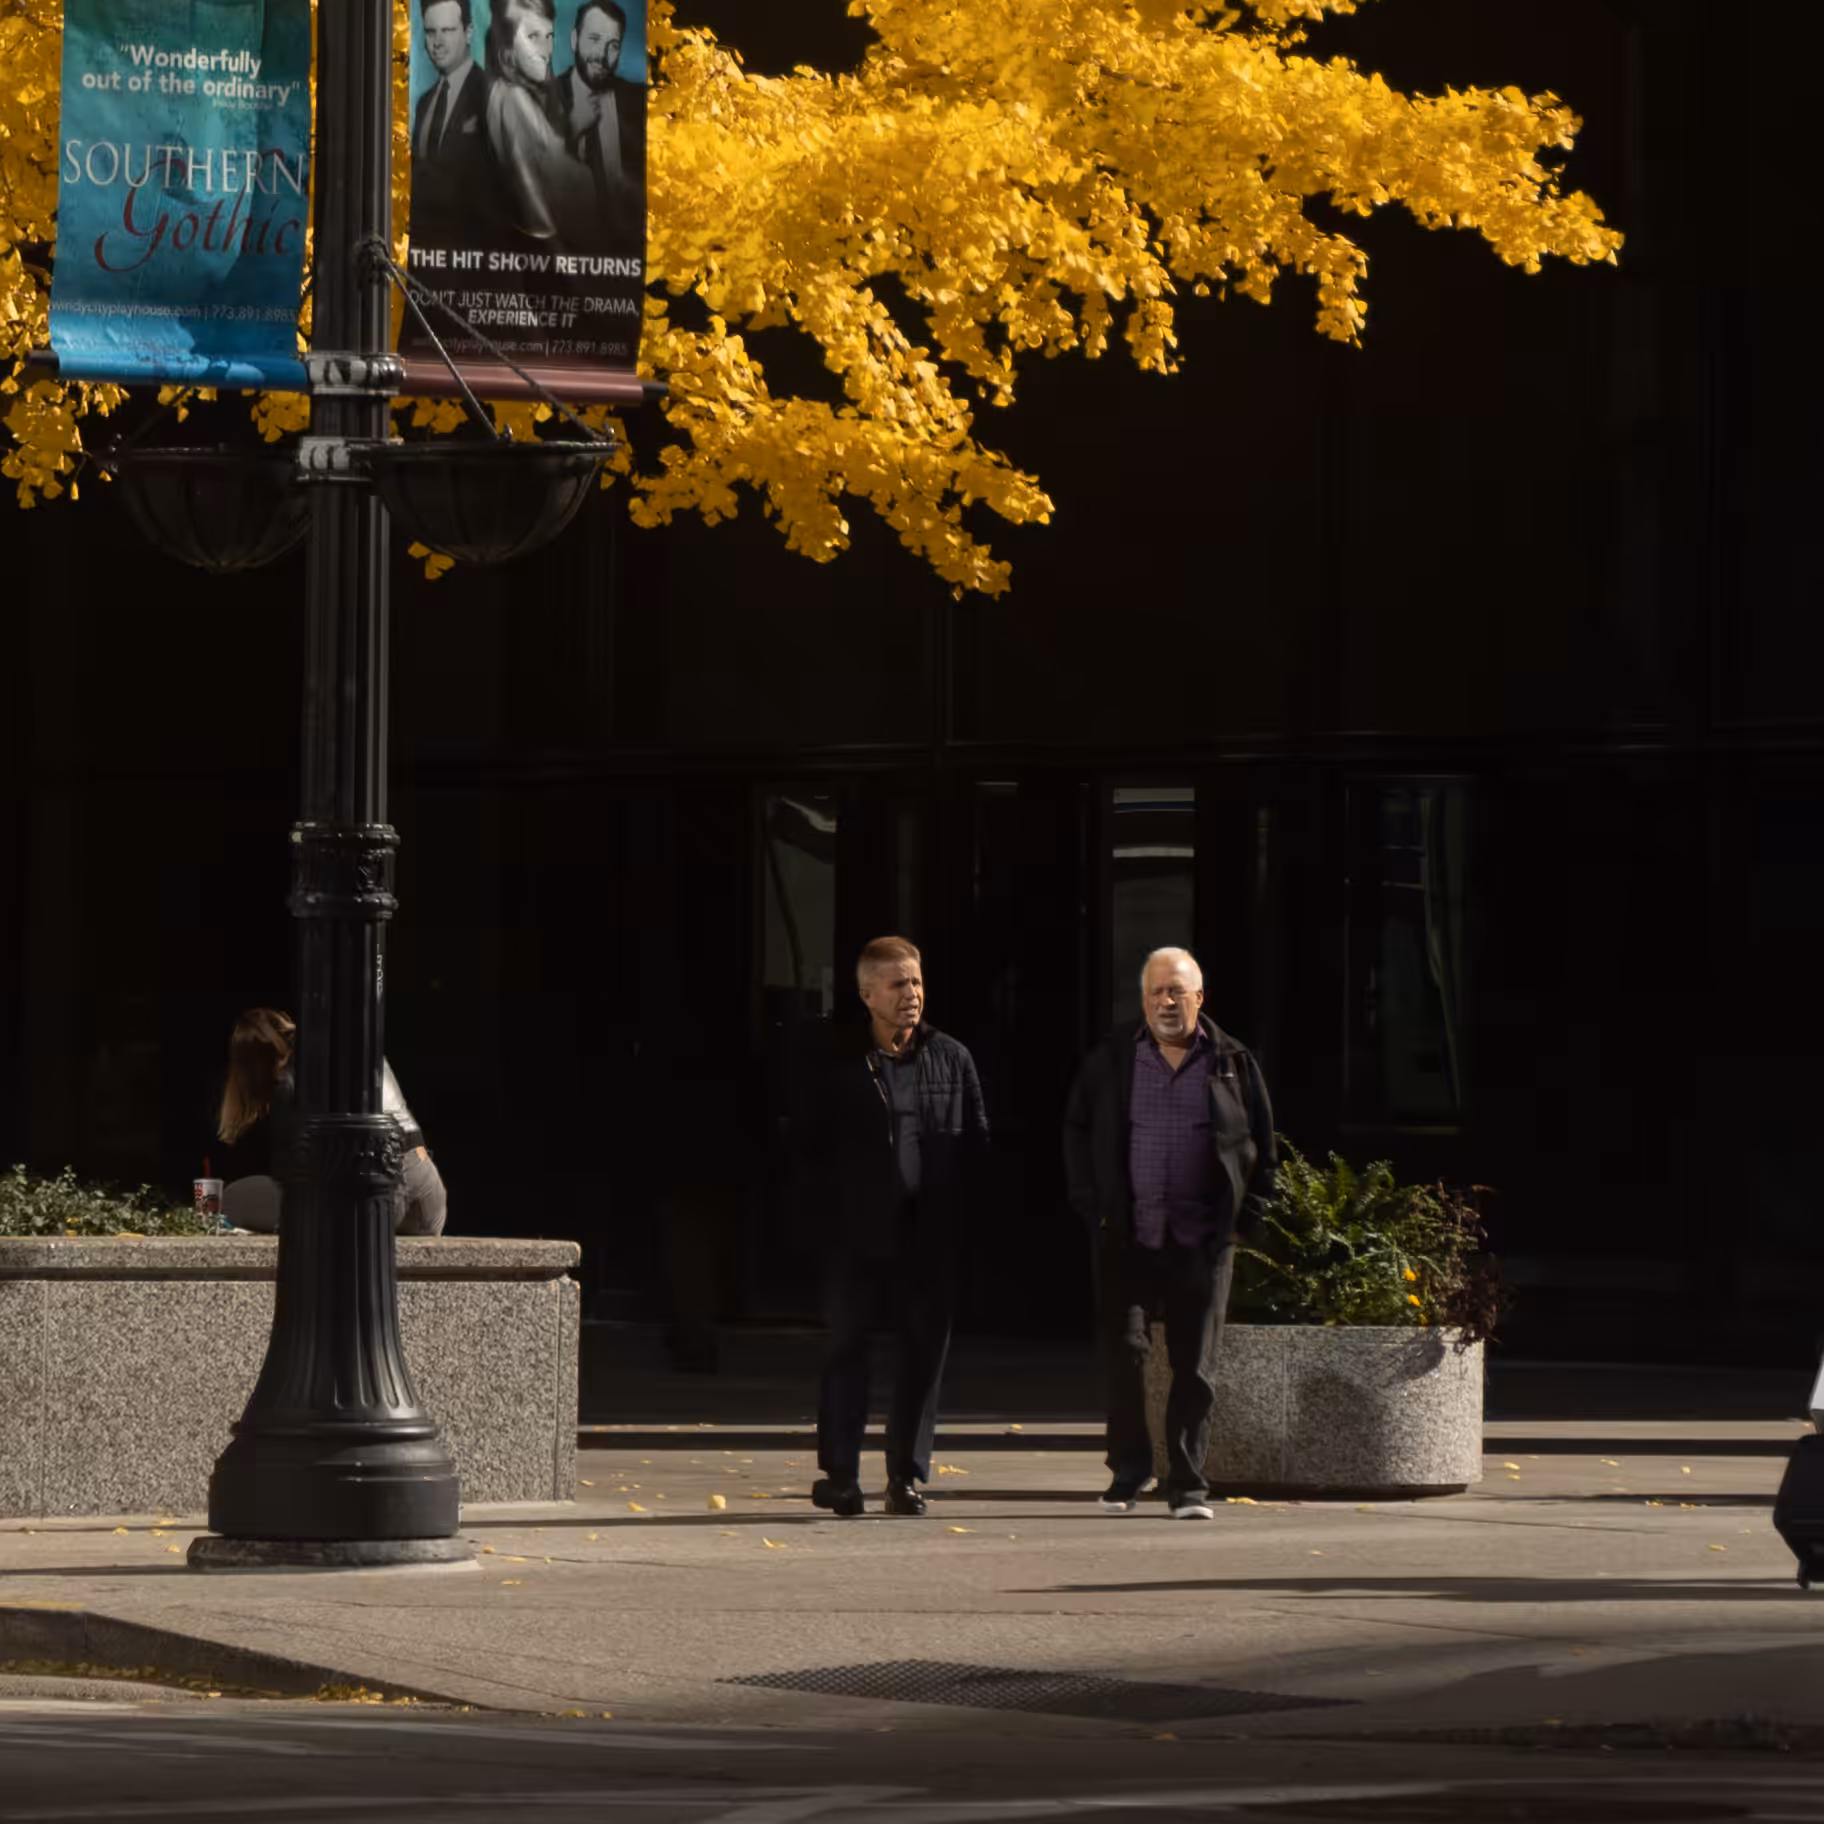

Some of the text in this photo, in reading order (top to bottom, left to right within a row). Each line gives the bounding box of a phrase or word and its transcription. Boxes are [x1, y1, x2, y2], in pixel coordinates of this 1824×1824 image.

[82, 72, 121, 90] out
[128, 70, 153, 92] of
[159, 71, 196, 95] the
[63, 139, 305, 196] SOUTHERN
[93, 150, 302, 274] Gothic
[410, 248, 642, 277] THE HIT SHOW RETURNS
[458, 290, 494, 309] JUST
[496, 293, 546, 311] WATCH
[550, 294, 579, 312] THE
[583, 296, 640, 317] DRAMA,
[468, 309, 577, 328] EXPERIENCE IT
